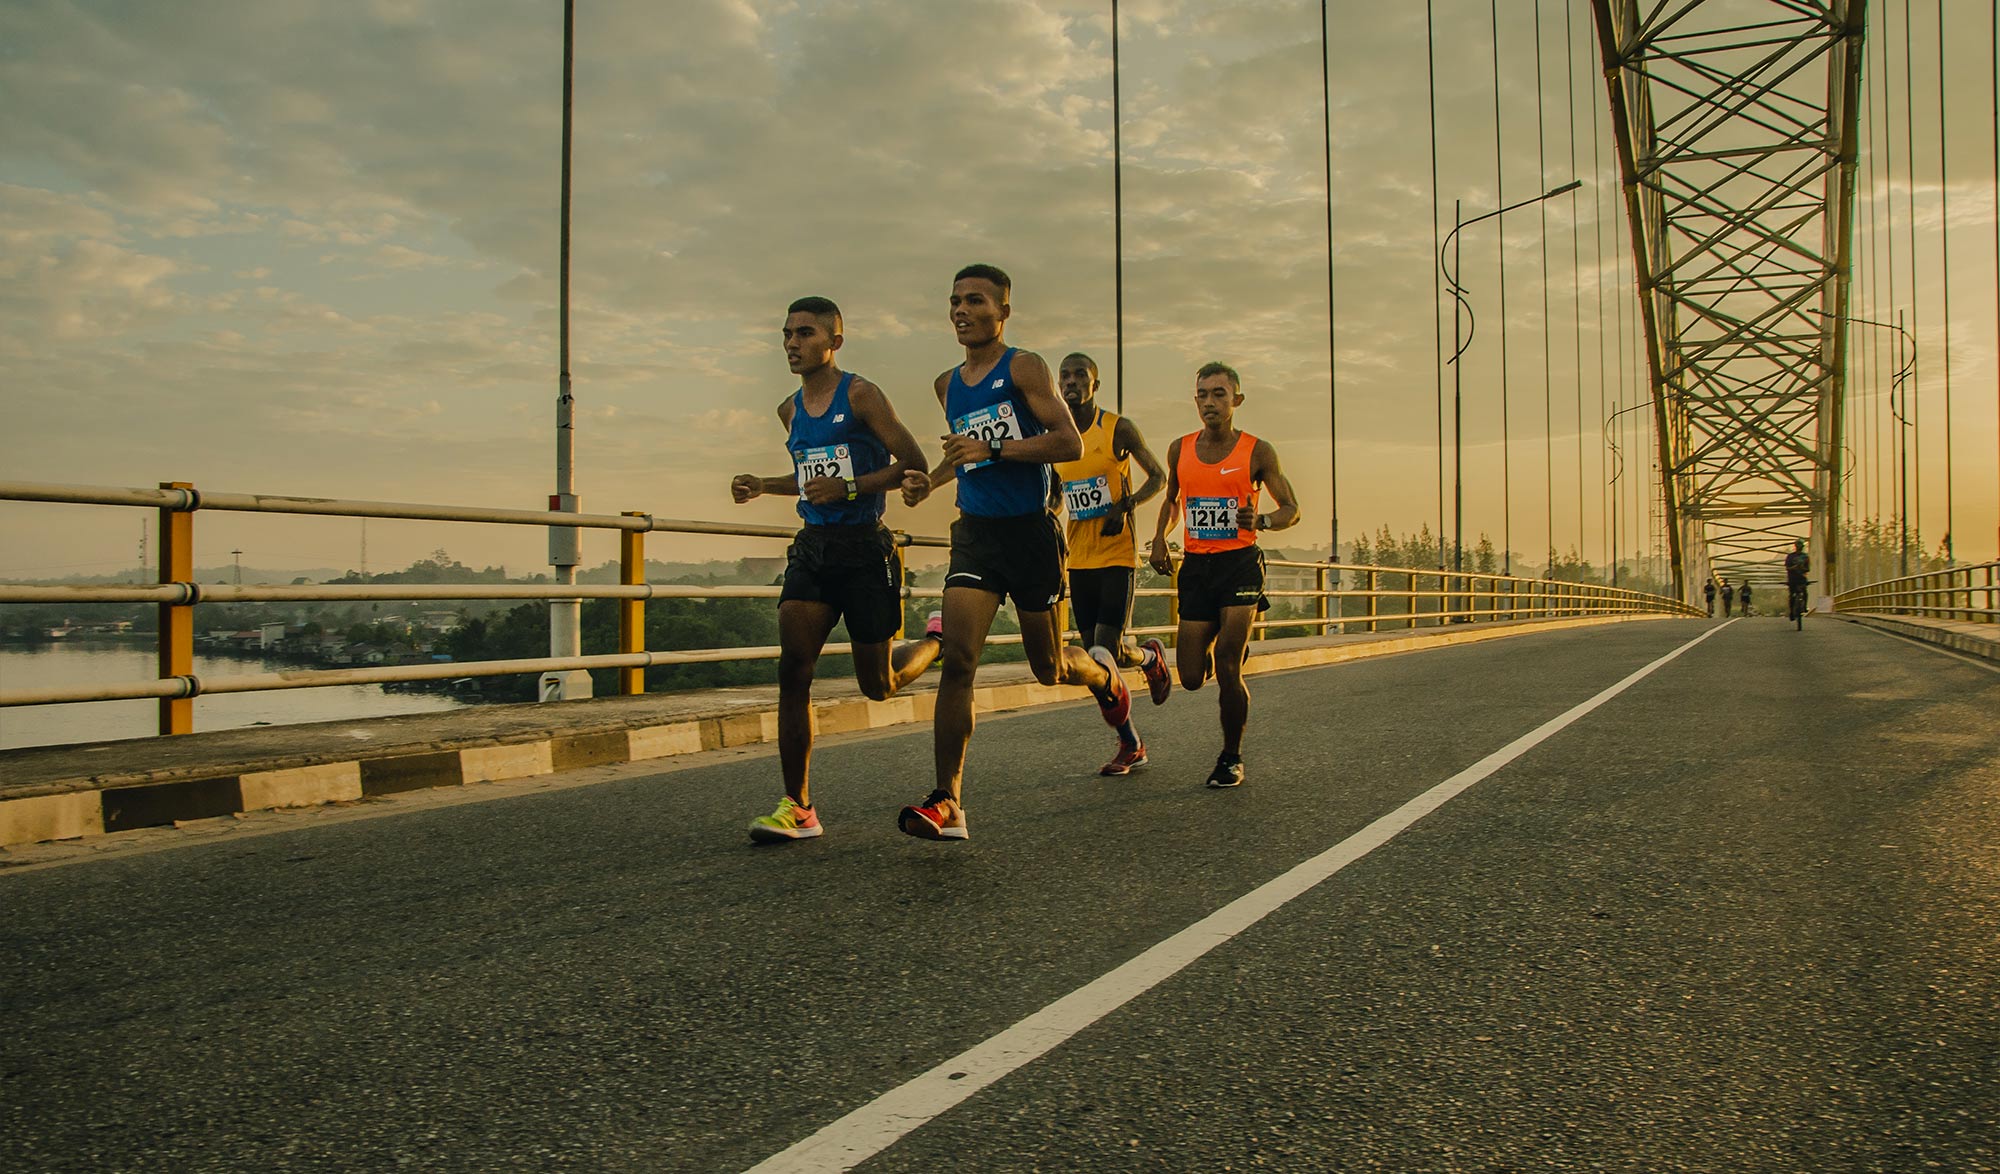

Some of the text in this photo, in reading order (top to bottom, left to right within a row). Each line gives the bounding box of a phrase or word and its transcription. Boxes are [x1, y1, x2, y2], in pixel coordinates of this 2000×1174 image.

[804, 462, 843, 481] 1182
[1068, 490, 1102, 509] 1109
[1191, 510, 1230, 527] 1214
